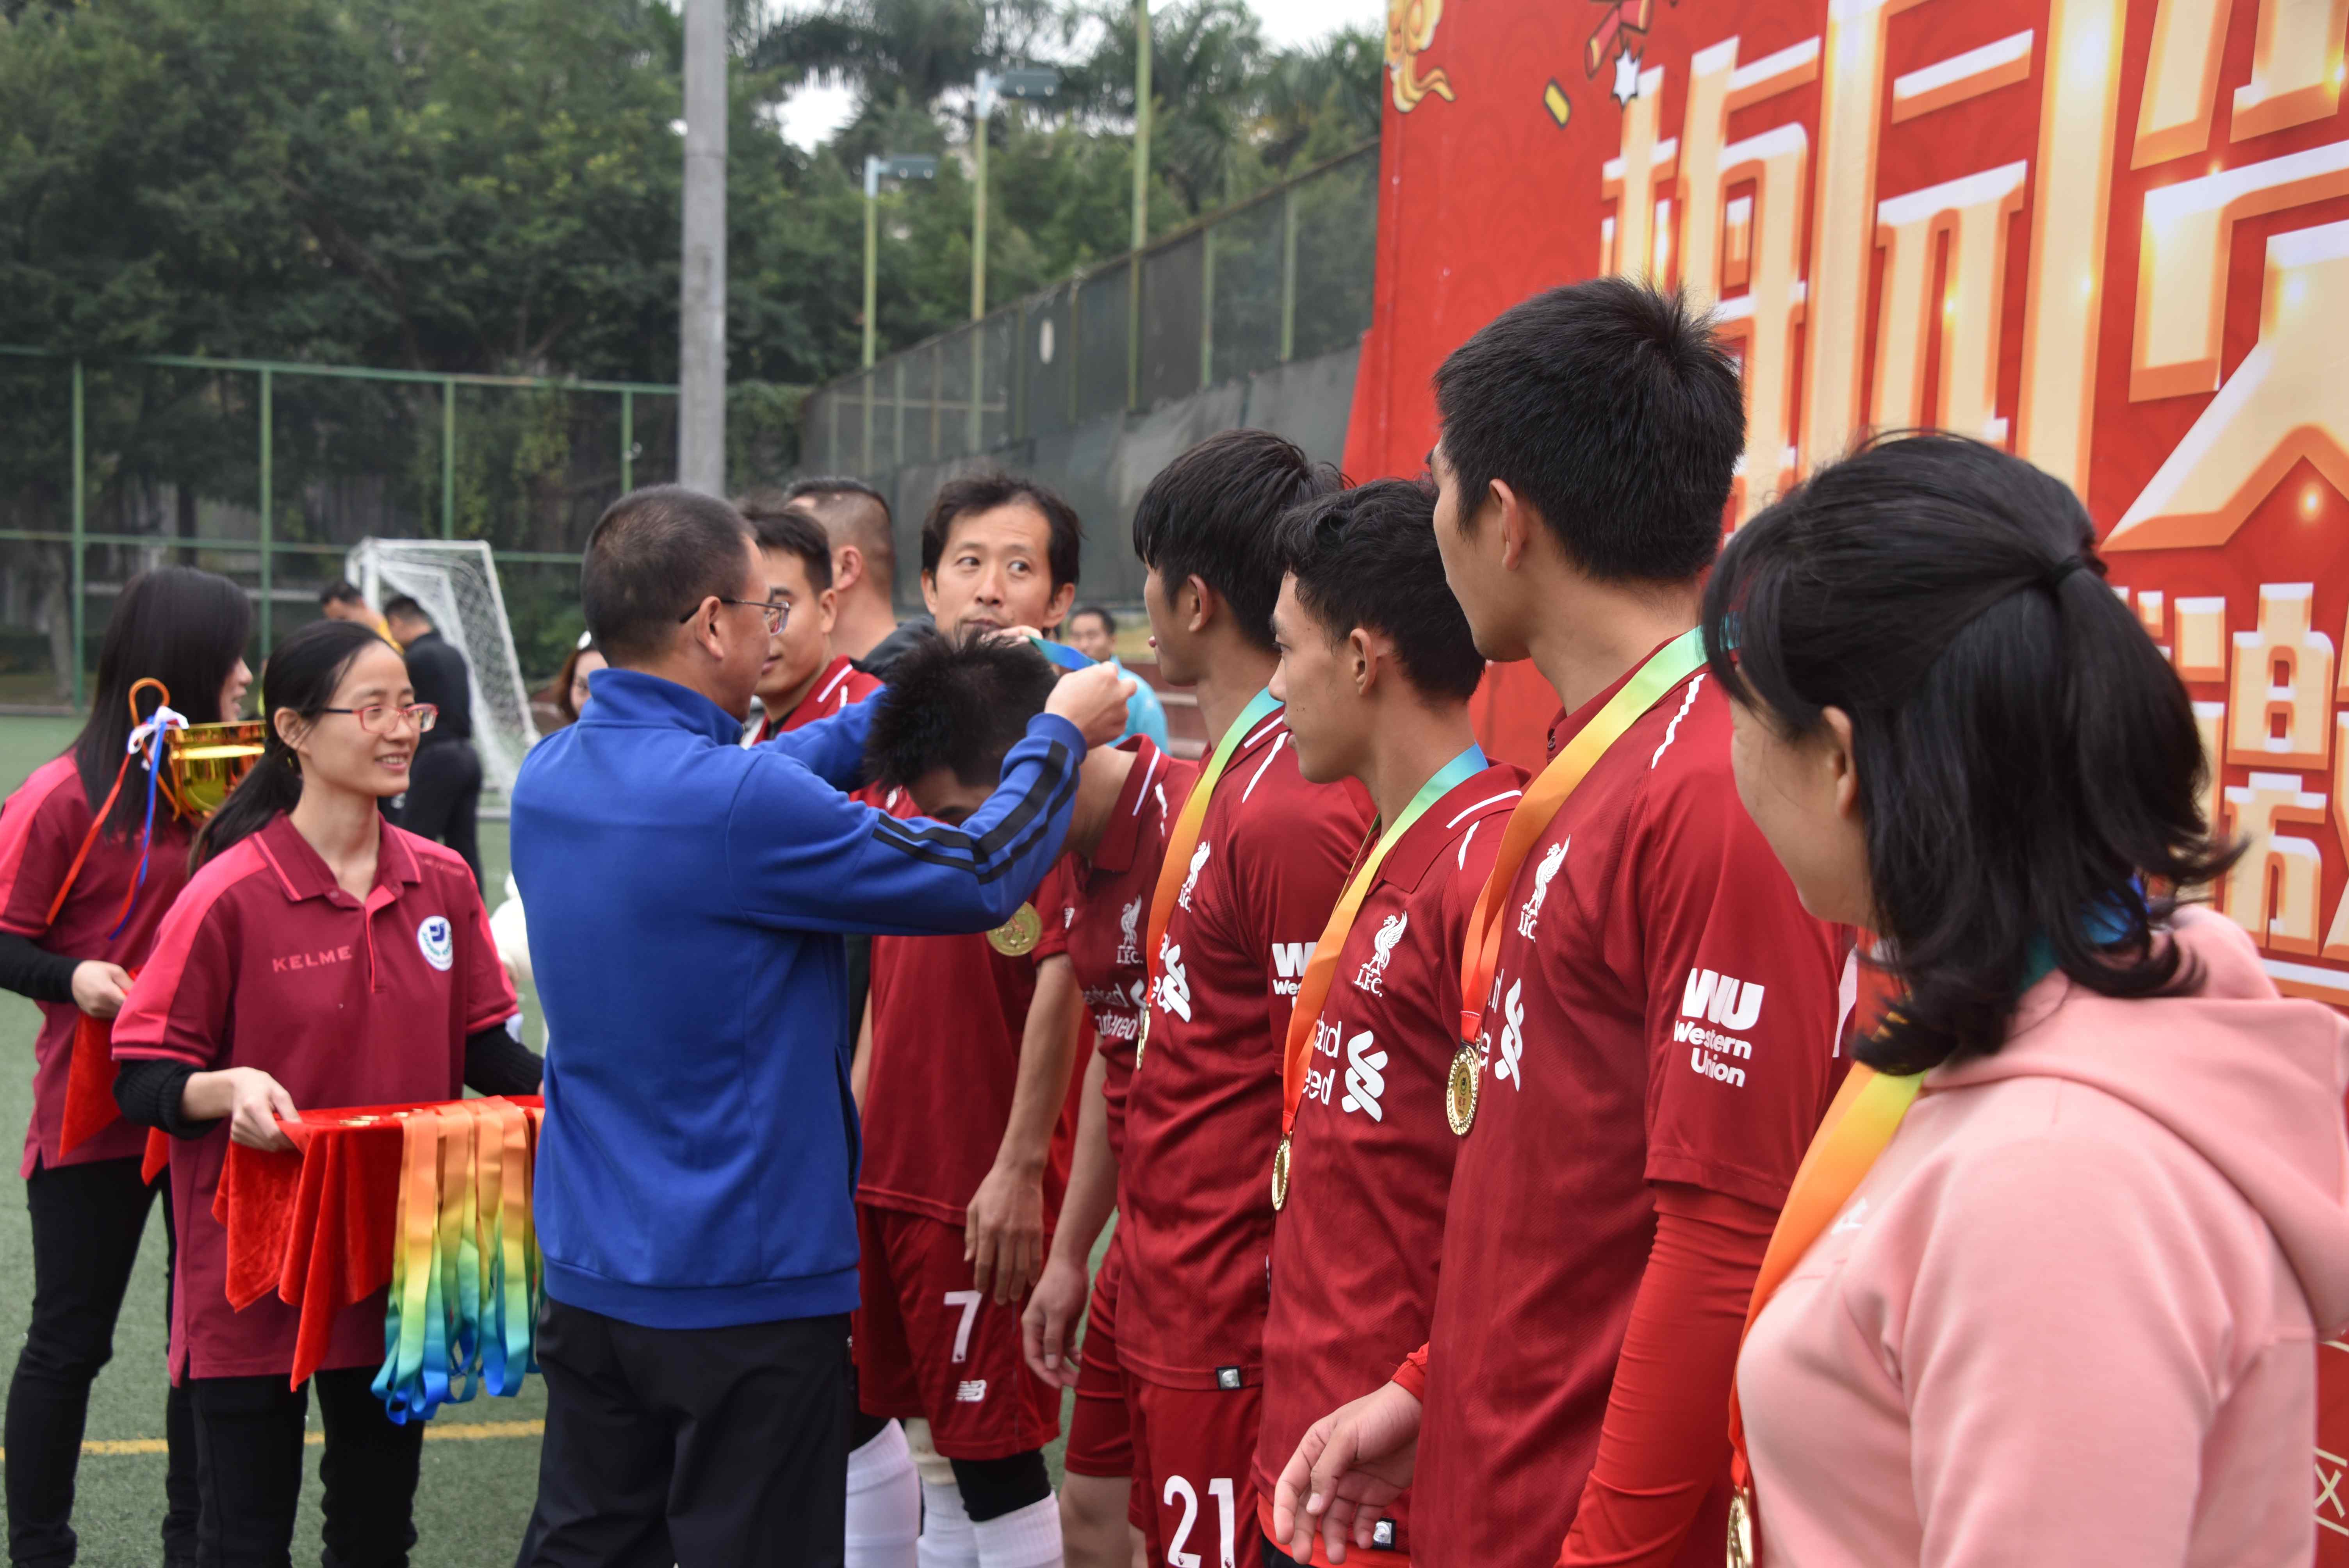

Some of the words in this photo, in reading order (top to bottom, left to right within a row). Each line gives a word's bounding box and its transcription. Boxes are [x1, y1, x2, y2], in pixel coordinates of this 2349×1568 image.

[272, 945, 351, 972] KELME
[1682, 968, 1764, 1030] WU
[1673, 1019, 1752, 1060] Western
[1691, 1047, 1745, 1087] Union
[945, 1289, 983, 1364] 7
[1163, 1475, 1236, 1568] 21
